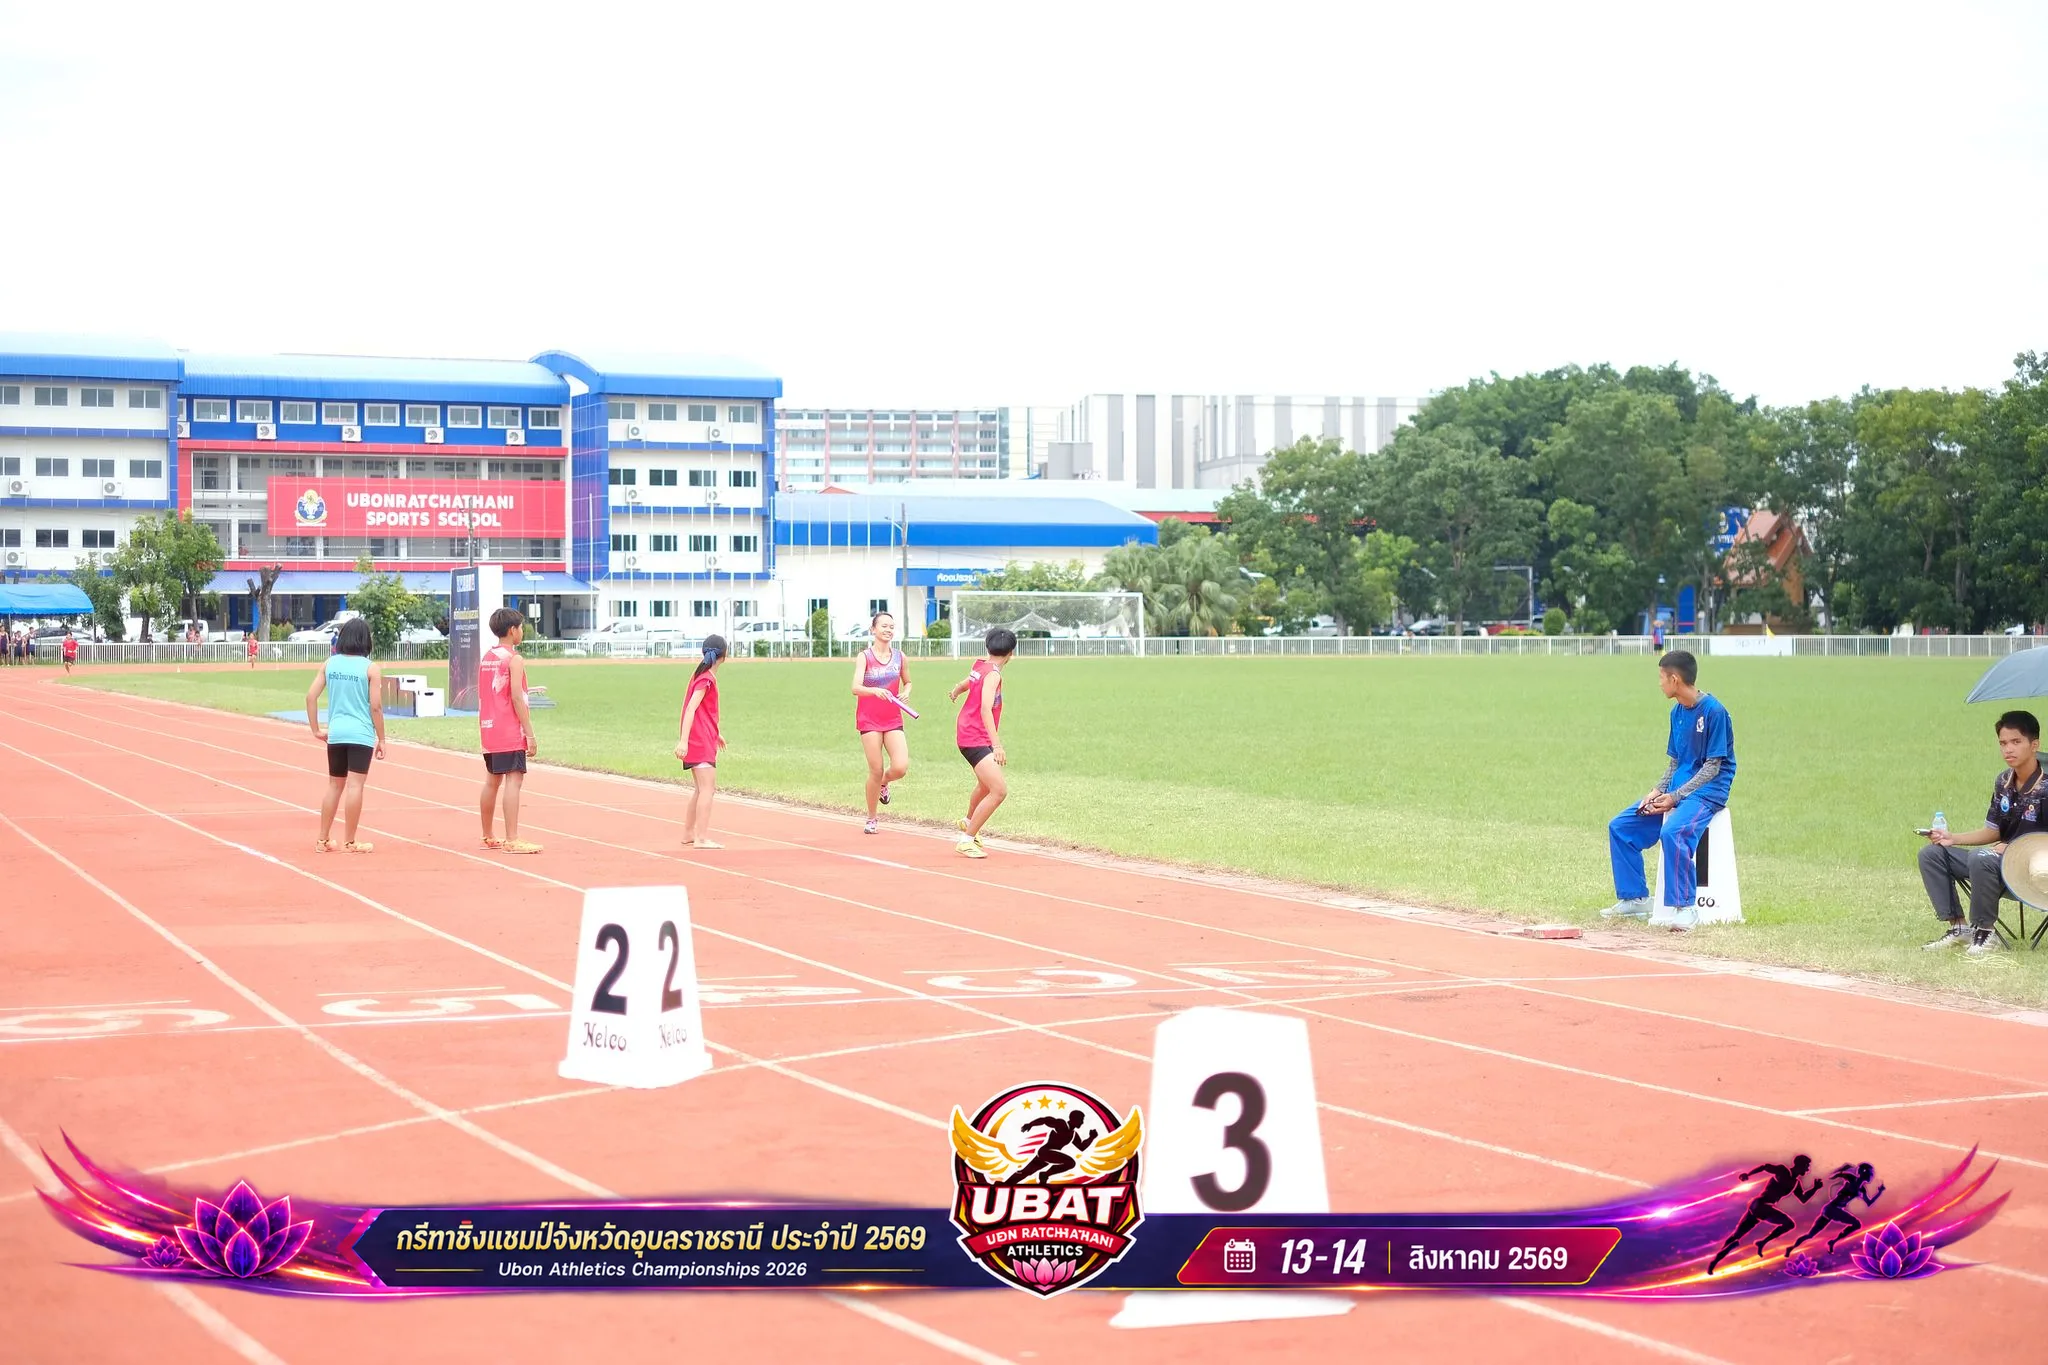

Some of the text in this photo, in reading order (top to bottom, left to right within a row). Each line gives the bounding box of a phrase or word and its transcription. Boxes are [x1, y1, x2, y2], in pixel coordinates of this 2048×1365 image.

[346, 492, 514, 510] UBONRATCHATHANI
[366, 511, 502, 527] SPORTS SCHOOL
[590, 922, 630, 1016] 2
[657, 919, 684, 1014] 2
[583, 1021, 627, 1052] Nelco
[658, 1022, 688, 1050] Nelco
[1189, 1071, 1273, 1213] 3
